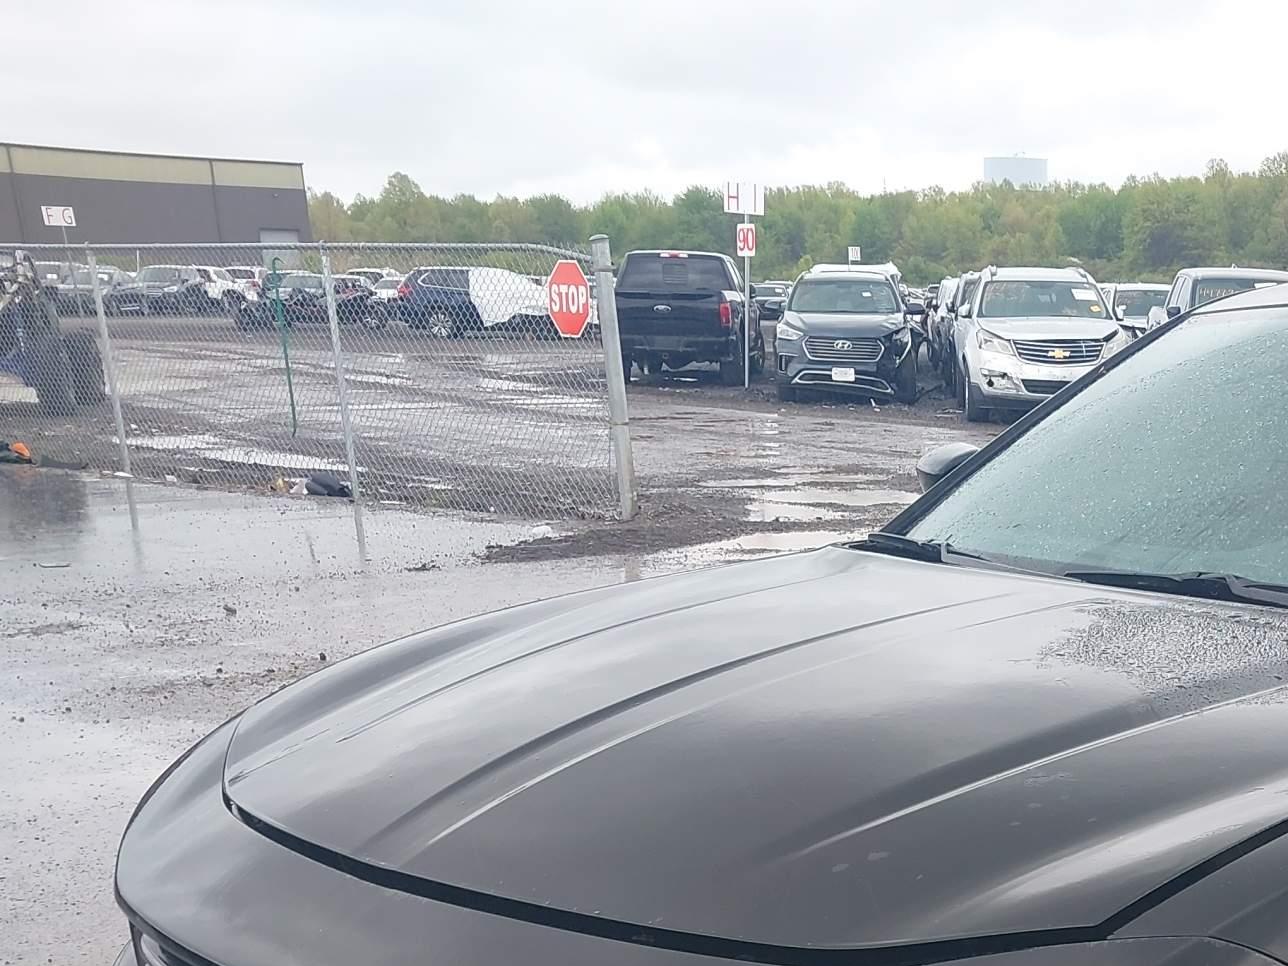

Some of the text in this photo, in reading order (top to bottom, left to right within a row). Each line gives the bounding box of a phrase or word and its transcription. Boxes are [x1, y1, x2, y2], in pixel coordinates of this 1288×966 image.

[727, 181, 739, 211] H
[45, 207, 74, 225] F G
[738, 227, 755, 252] 90
[551, 283, 587, 314] STOP
